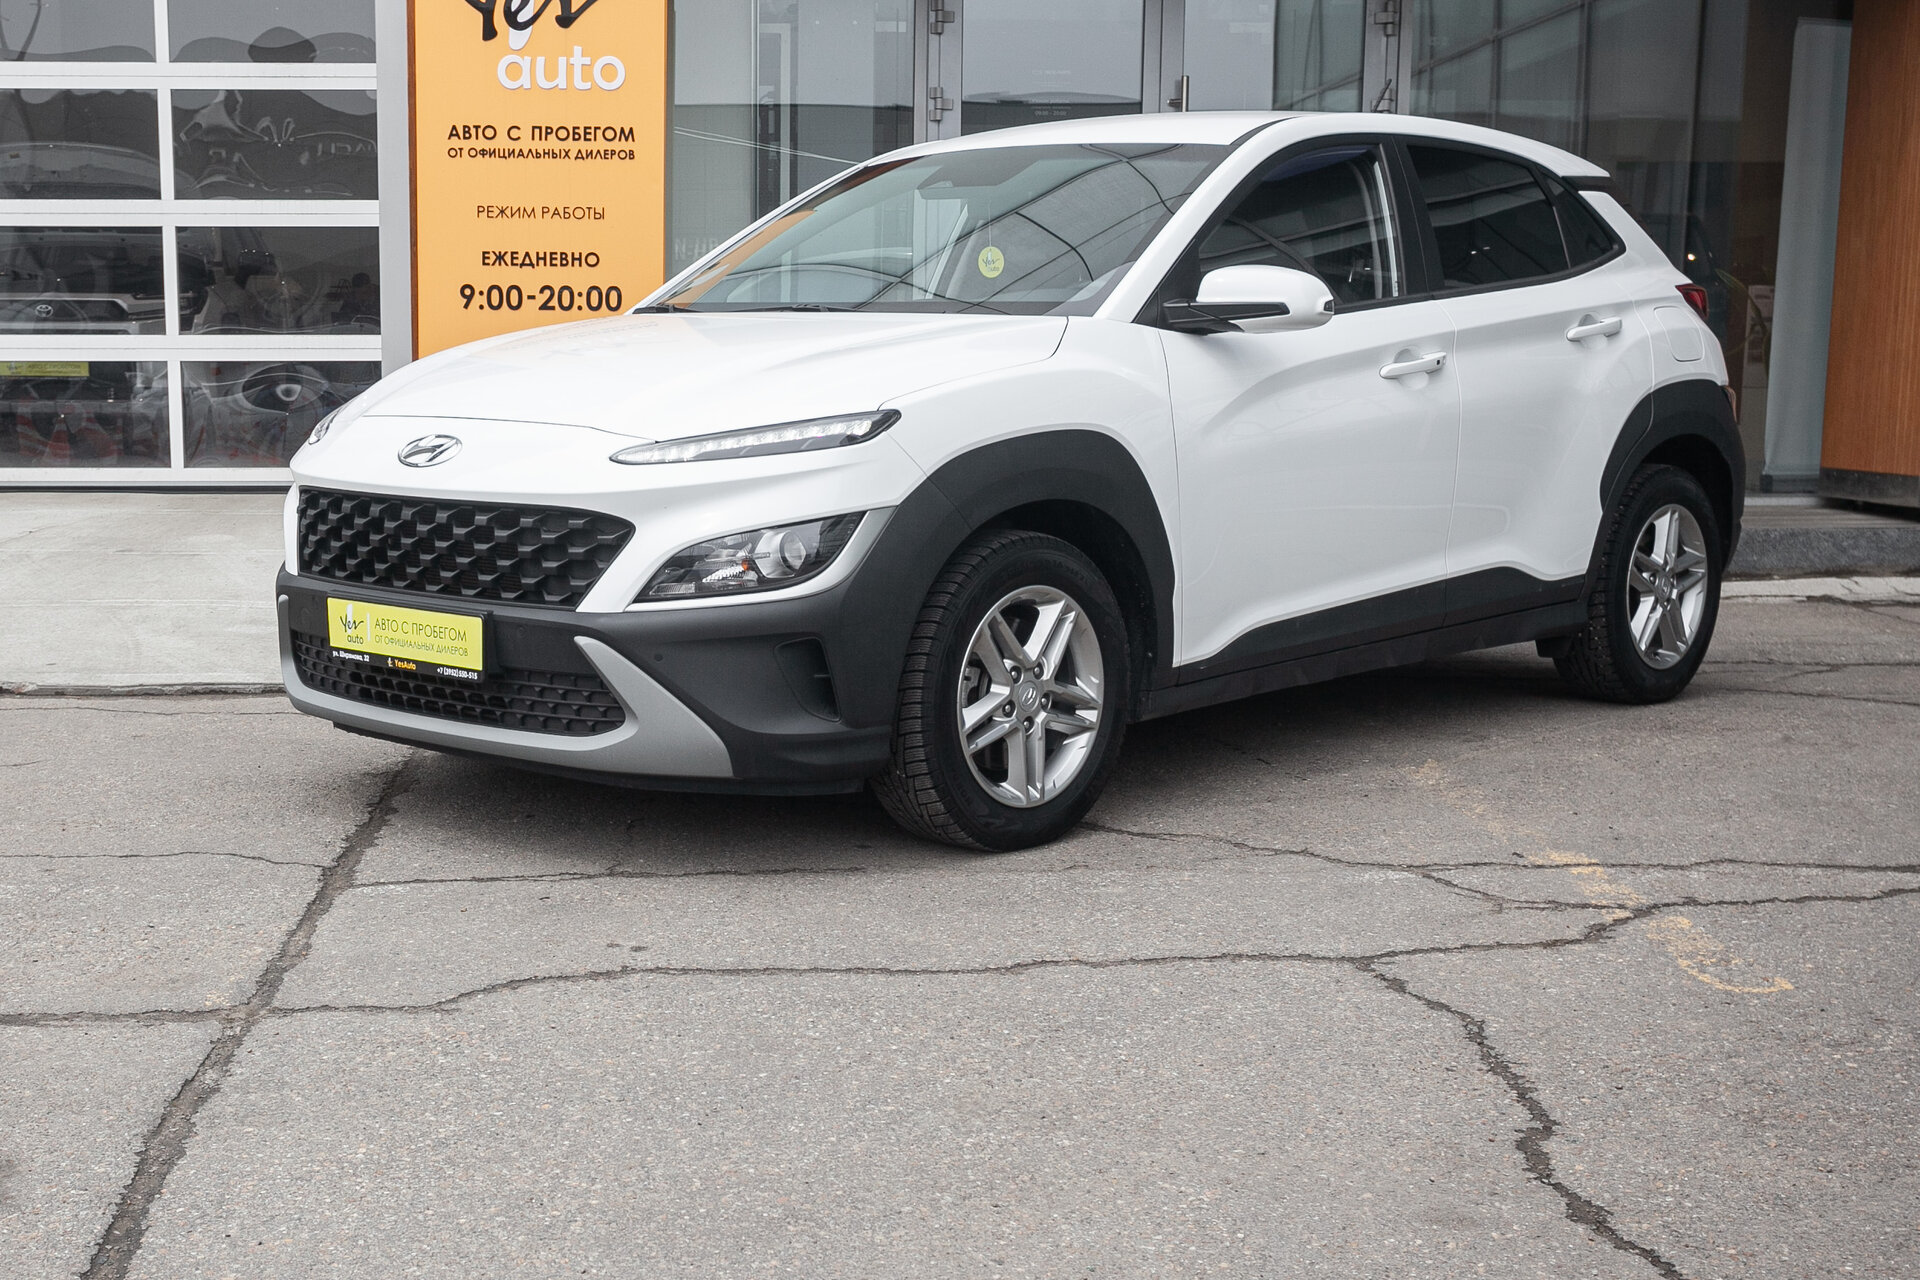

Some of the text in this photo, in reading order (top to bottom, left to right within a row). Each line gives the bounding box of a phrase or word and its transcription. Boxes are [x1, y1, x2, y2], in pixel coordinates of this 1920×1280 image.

[497, 45, 626, 91] auto
[447, 125, 636, 142] АВТО С ПРОБЕГОМ
[447, 147, 636, 161] ОТ ОФИЦИАЛЬНЫХ ДИЛЕРОВ
[476, 205, 605, 220] РЕЖИМ РАБОТЫ
[481, 251, 600, 269] ЕЖЕДНЕВНО
[459, 283, 623, 312] 9:00-20:00
[375, 618, 467, 642] АВТО С ПРОБЕГОМ
[347, 634, 364, 644] auto
[375, 634, 469, 656] ОТ ОФИЦИАЛЬНЫХ ДИЛЕРОВ
[394, 659, 416, 670] YesAuto
